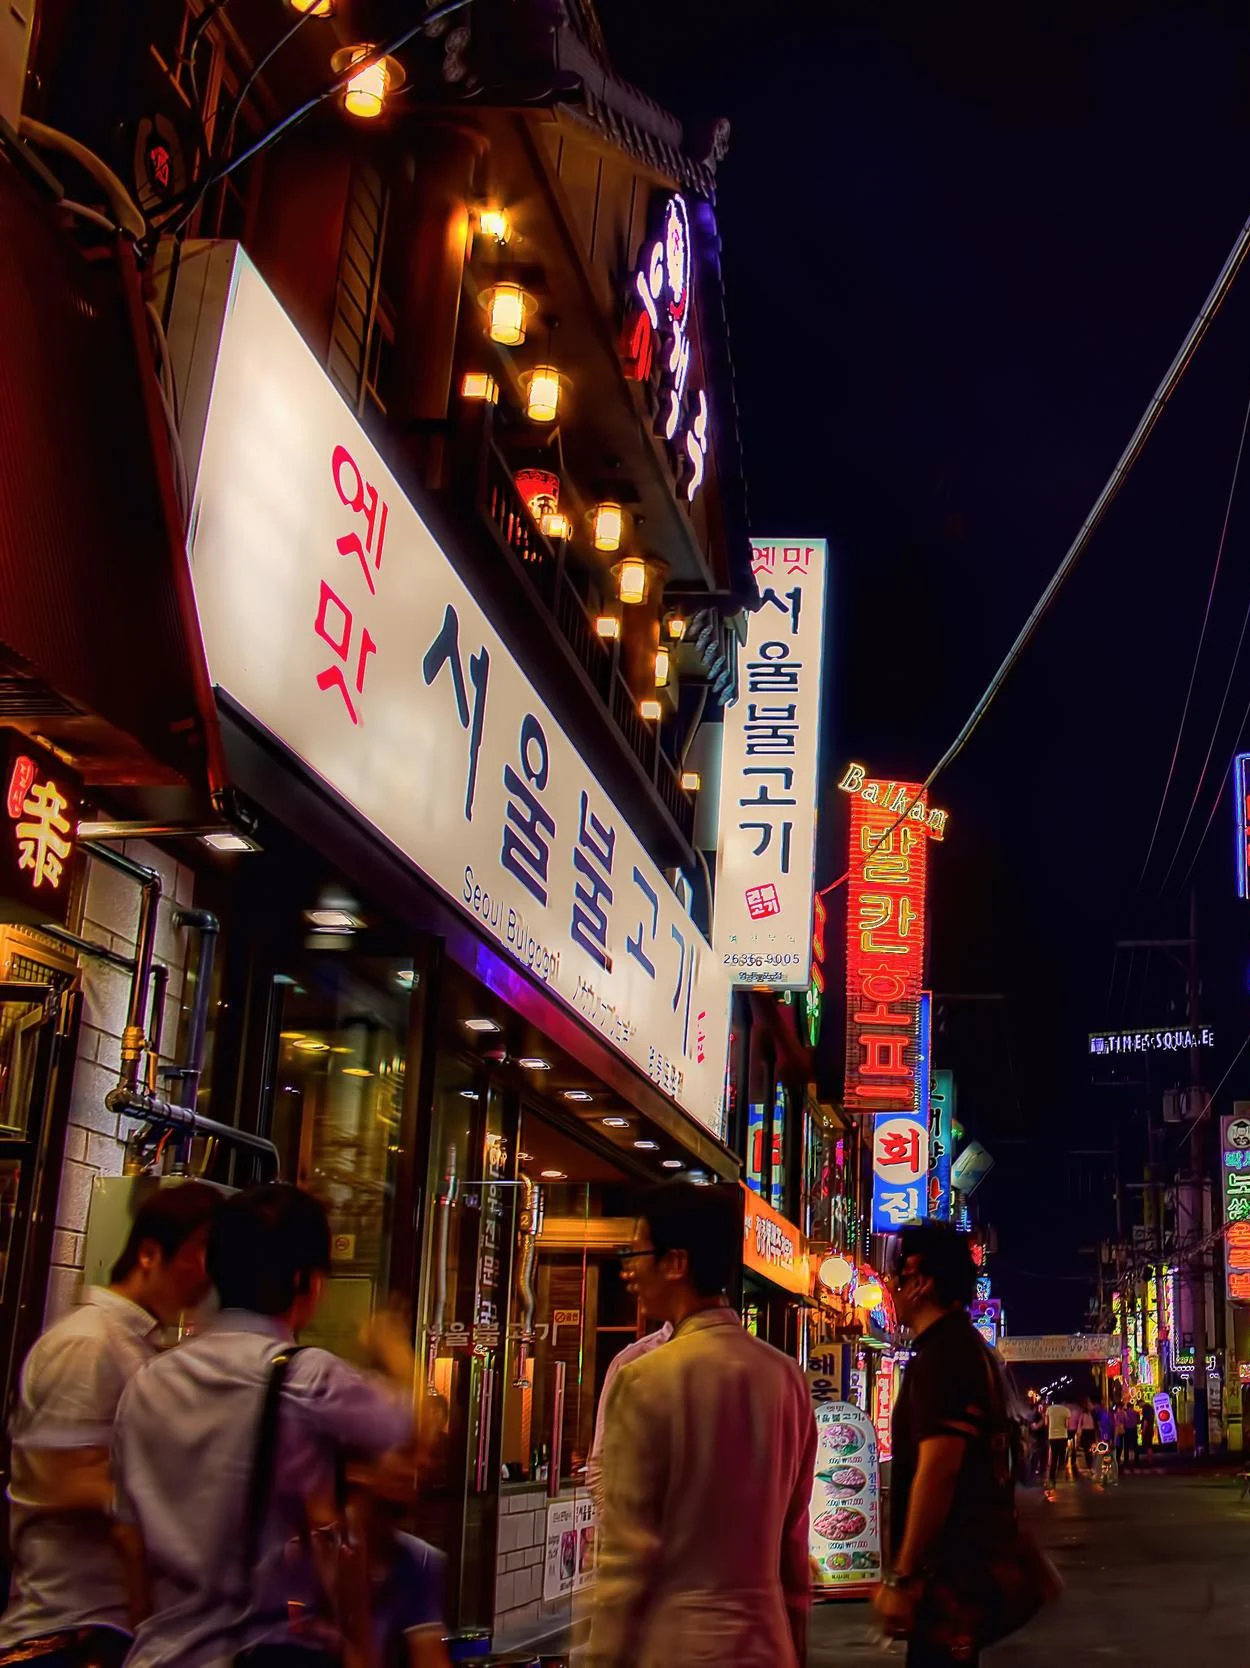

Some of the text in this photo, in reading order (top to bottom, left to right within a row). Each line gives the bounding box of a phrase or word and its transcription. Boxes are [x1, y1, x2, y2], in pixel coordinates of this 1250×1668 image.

[314, 445, 388, 725] 옛맛
[739, 586, 803, 874] 서울불고기
[423, 603, 694, 1056] 서울불고기
[838, 763, 948, 840] Balkan
[463, 866, 503, 928] Seoul
[859, 826, 918, 954] 발칸
[1156, 1029, 1214, 1051] SQUAE
[876, 1128, 922, 1225] 회집
